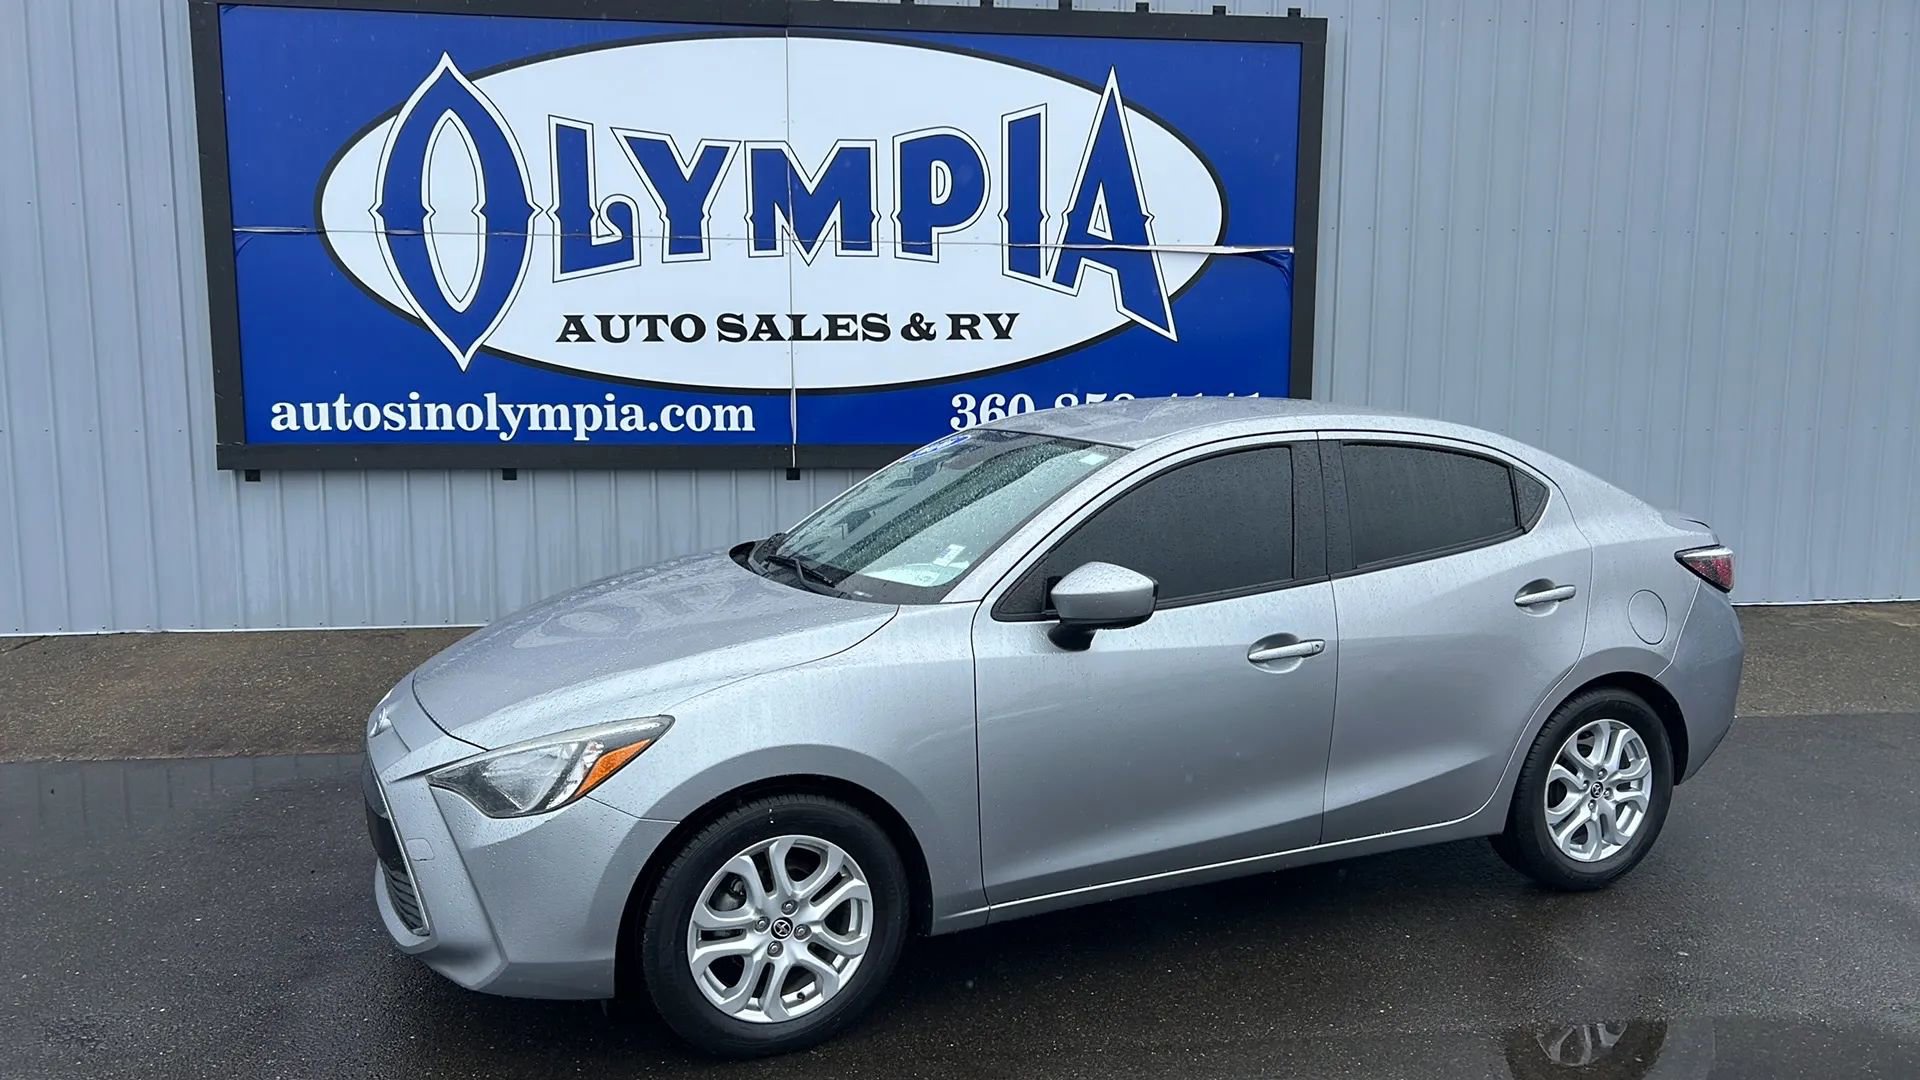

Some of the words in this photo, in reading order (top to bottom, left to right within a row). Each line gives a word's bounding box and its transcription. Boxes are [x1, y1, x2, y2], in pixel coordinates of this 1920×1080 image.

[368, 51, 1178, 372] OLYMPIA
[556, 314, 706, 343] AUTO
[717, 313, 891, 342] SALES
[900, 312, 936, 341] &
[946, 313, 1020, 340] RV
[271, 392, 756, 441] autosinolympia.com
